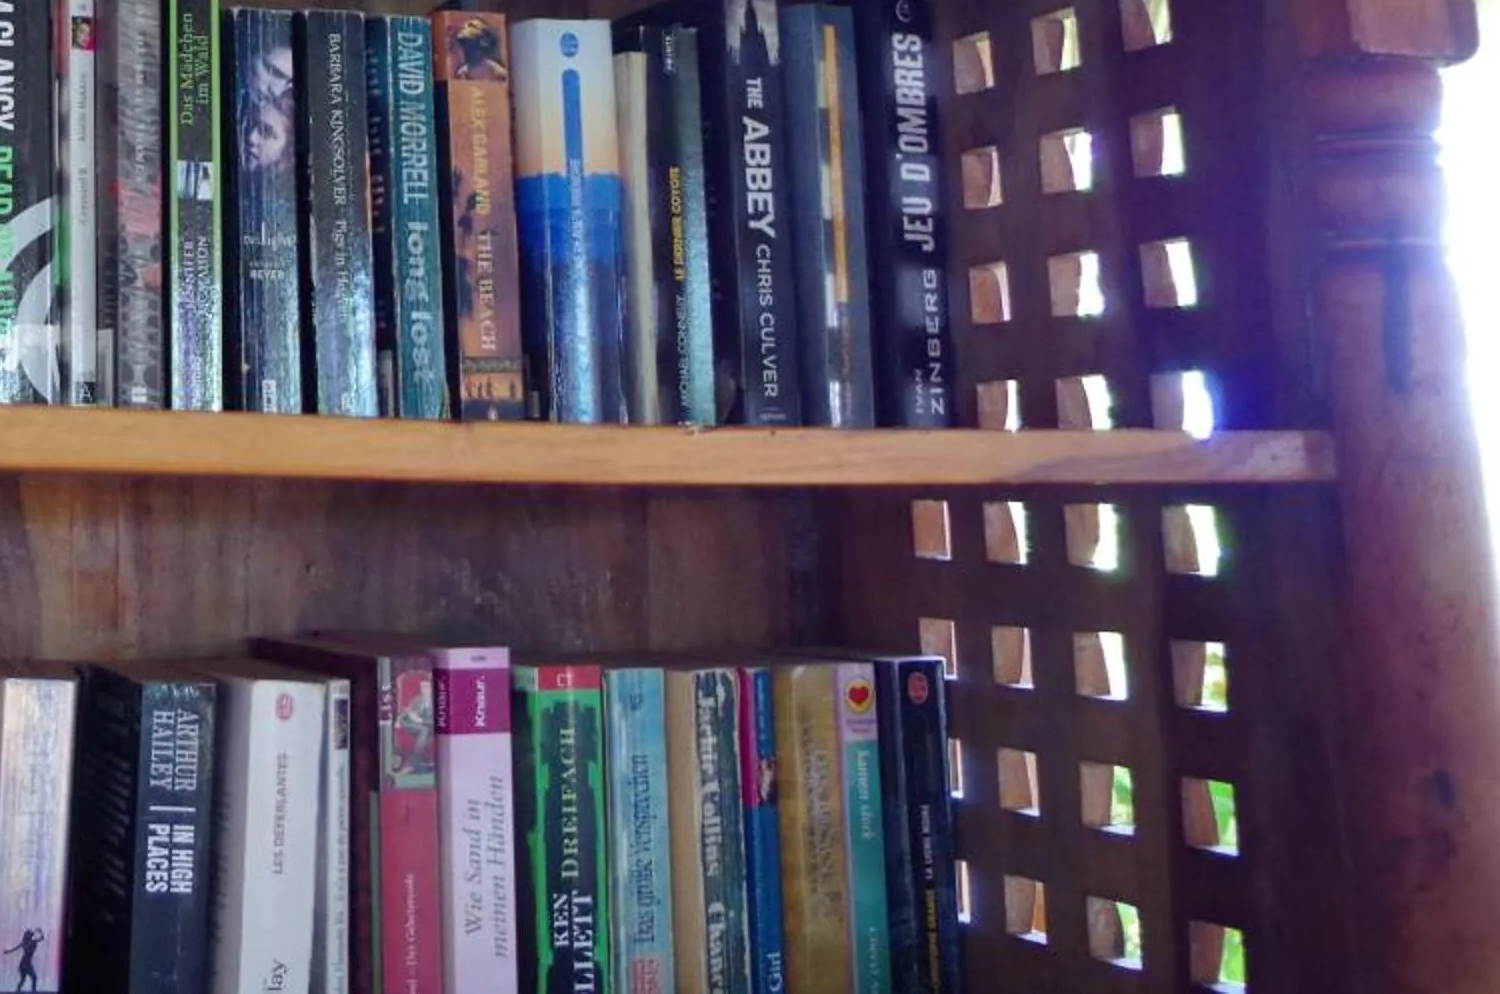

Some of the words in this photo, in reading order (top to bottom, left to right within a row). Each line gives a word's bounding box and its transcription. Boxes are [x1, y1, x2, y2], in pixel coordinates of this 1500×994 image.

[179, 13, 194, 90] Mädchen
[194, 35, 209, 79] Wald
[328, 33, 344, 105] BARBARA
[397, 31, 424, 96] DAVID
[180, 95, 194, 125] Das
[195, 85, 209, 105] im
[470, 86, 486, 130] ALEX
[745, 77, 763, 108] THE
[329, 108, 347, 205] KINGSOLVER
[399, 100, 429, 204] MORRELL
[472, 133, 490, 215] GARLAND
[741, 116, 776, 238] ABBEY
[332, 221, 348, 248] Pigs
[477, 230, 494, 276] THE
[901, 200, 936, 252] JEU
[756, 244, 772, 306] CHRIS
[478, 280, 497, 351] BEACH
[923, 269, 946, 416] ZINBERG
[758, 311, 779, 398] CULVER
[915, 369, 925, 414] IVAN
[150, 709, 175, 791] HAILEY
[174, 708, 199, 791] ARTHUR
[698, 691, 719, 776] Jackie
[172, 825, 195, 844] IN
[468, 798, 481, 821] in
[484, 775, 506, 865] Händen
[559, 728, 579, 879] DREIFACH
[701, 782, 724, 877] Collins
[145, 824, 170, 893] PLACES
[170, 849, 194, 894] HIGH
[463, 827, 482, 884] Sand
[465, 892, 482, 937] Wie
[492, 875, 510, 959] meinen
[554, 892, 570, 947] KEN
[571, 889, 595, 994] LLETT
